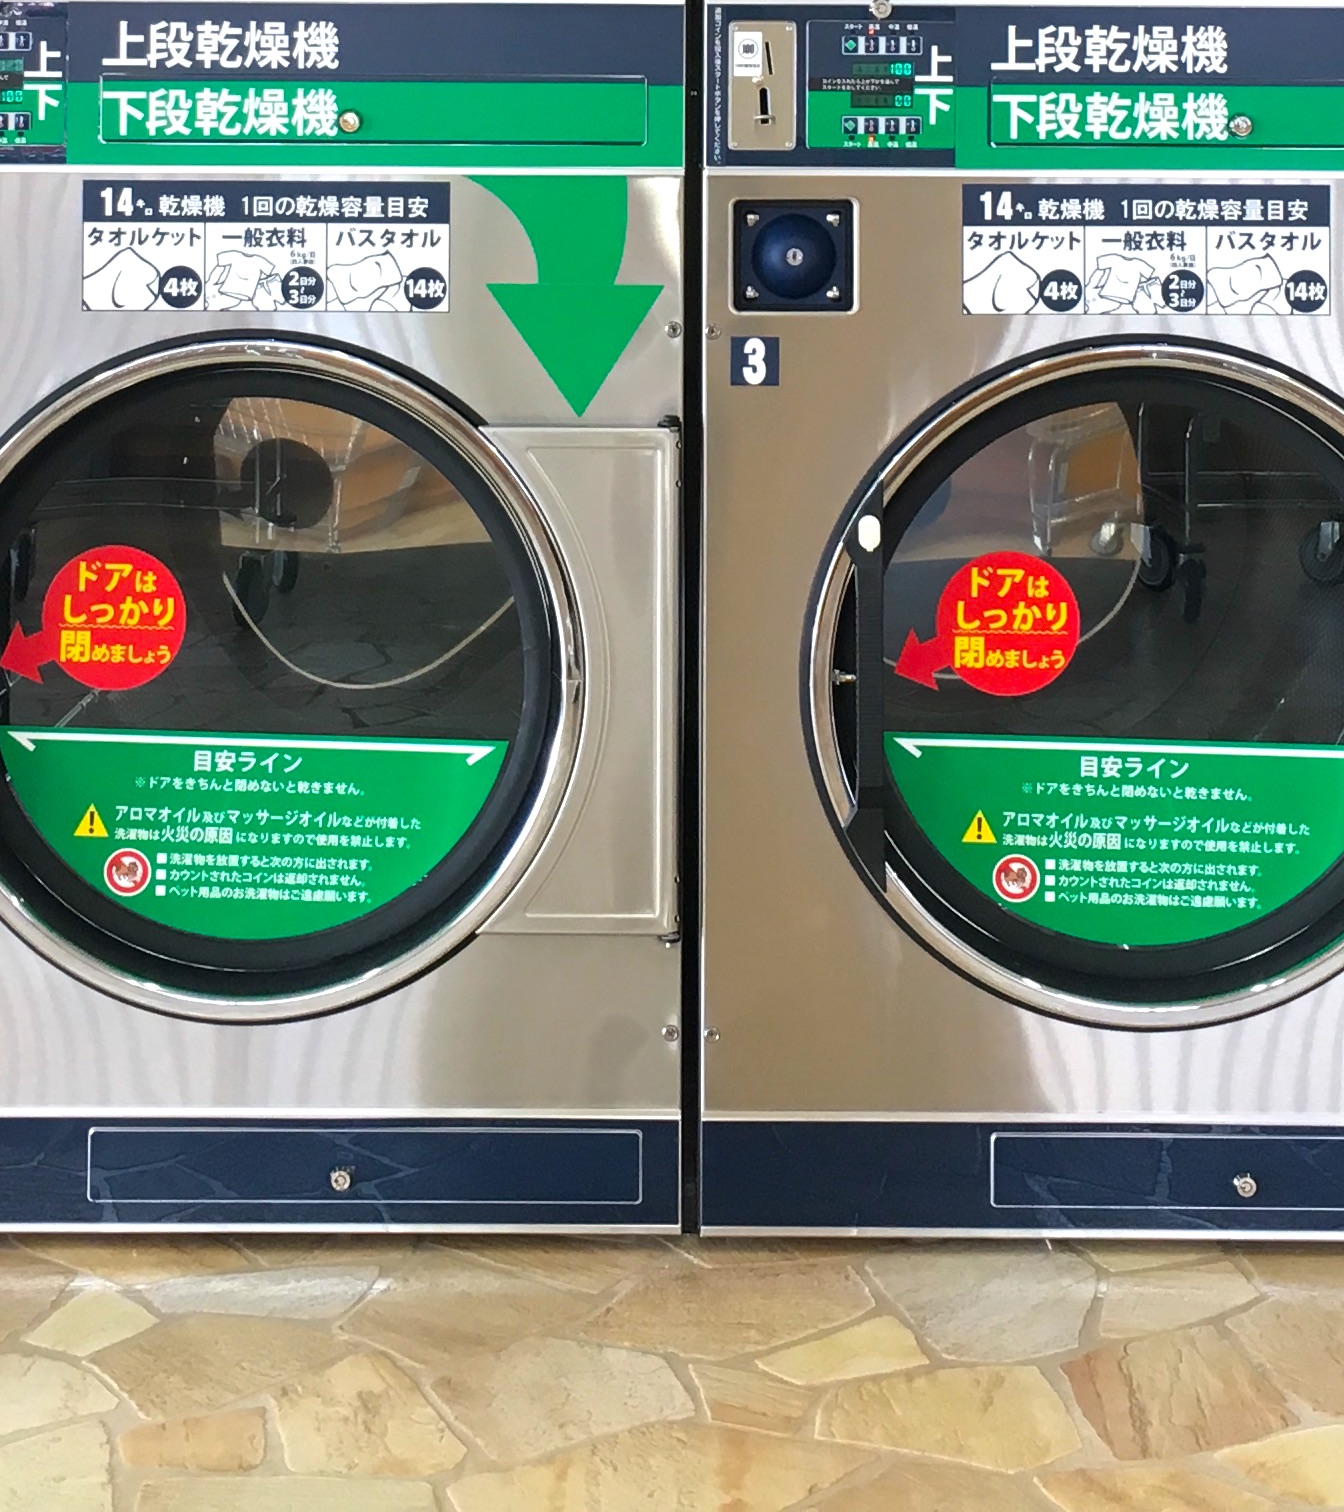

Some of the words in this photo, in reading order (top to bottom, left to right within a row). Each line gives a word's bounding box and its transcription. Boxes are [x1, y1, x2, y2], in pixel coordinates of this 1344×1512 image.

[102, 21, 339, 69] 上段乾燥機
[991, 26, 1228, 74] 上段乾燥機
[25, 41, 62, 77] 上
[889, 63, 913, 76] 100
[916, 45, 954, 82] 上
[24, 84, 62, 121] 下
[102, 89, 339, 137] 下段乾燥機
[915, 89, 954, 125] 下
[992, 94, 1229, 142] 下段乾燥機
[241, 194, 428, 218] 1回の乾燥容量目安
[1120, 198, 1308, 222] 1回の乾燥容量目安
[88, 228, 201, 247] タオルケット
[222, 228, 307, 247] 一般衣料
[335, 228, 441, 248] バスタオル
[968, 231, 1081, 251] タオルケット
[1101, 232, 1187, 250] 一般衣料
[1215, 232, 1322, 250] バスタオル
[164, 277, 198, 298] 4枚
[289, 272, 317, 287] 2日分
[407, 277, 445, 298] 14枚
[1044, 279, 1077, 301] 4枚
[1169, 276, 1197, 291] 2日分
[1287, 279, 1325, 301] 14枚
[289, 290, 317, 305] 3日分
[1169, 294, 1197, 308] 3日分
[743, 339, 767, 384] 3
[78, 561, 156, 592] ドアは
[969, 567, 1049, 598] ドアは
[63, 595, 174, 626] しっかり
[956, 600, 1068, 631] しっかり
[59, 631, 172, 664] 閉めましょう
[954, 637, 1065, 669] 閉めましょう
[193, 750, 303, 773] 目安ライン
[1080, 756, 1190, 779] 目安ライン
